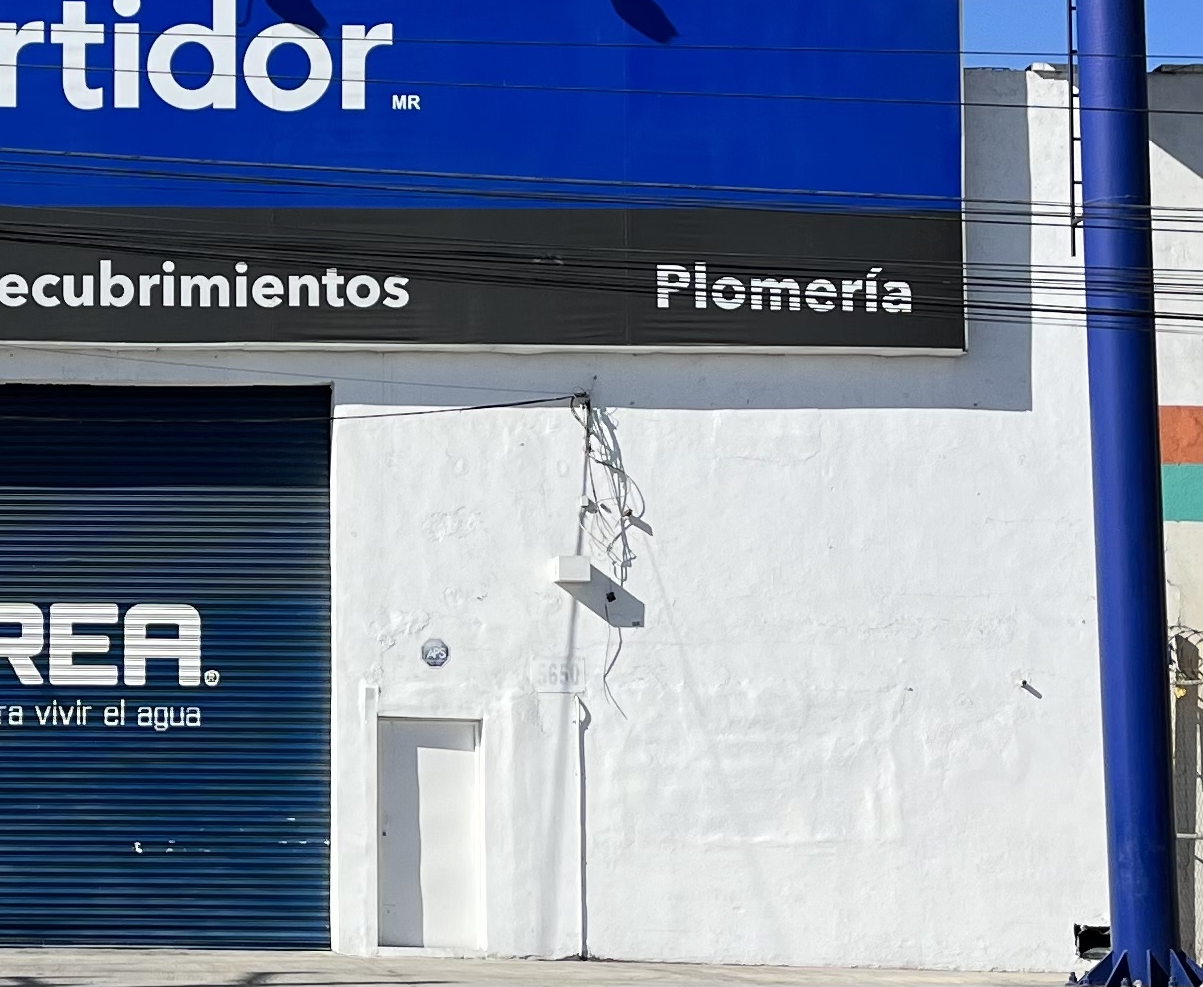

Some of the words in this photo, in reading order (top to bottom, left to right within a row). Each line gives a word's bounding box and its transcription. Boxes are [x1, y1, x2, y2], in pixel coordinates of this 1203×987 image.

[392, 94, 421, 110] MR
[656, 260, 913, 313] Plomería
[35, 699, 93, 727] vivir
[103, 699, 127, 727] el
[137, 705, 202, 731] agua
